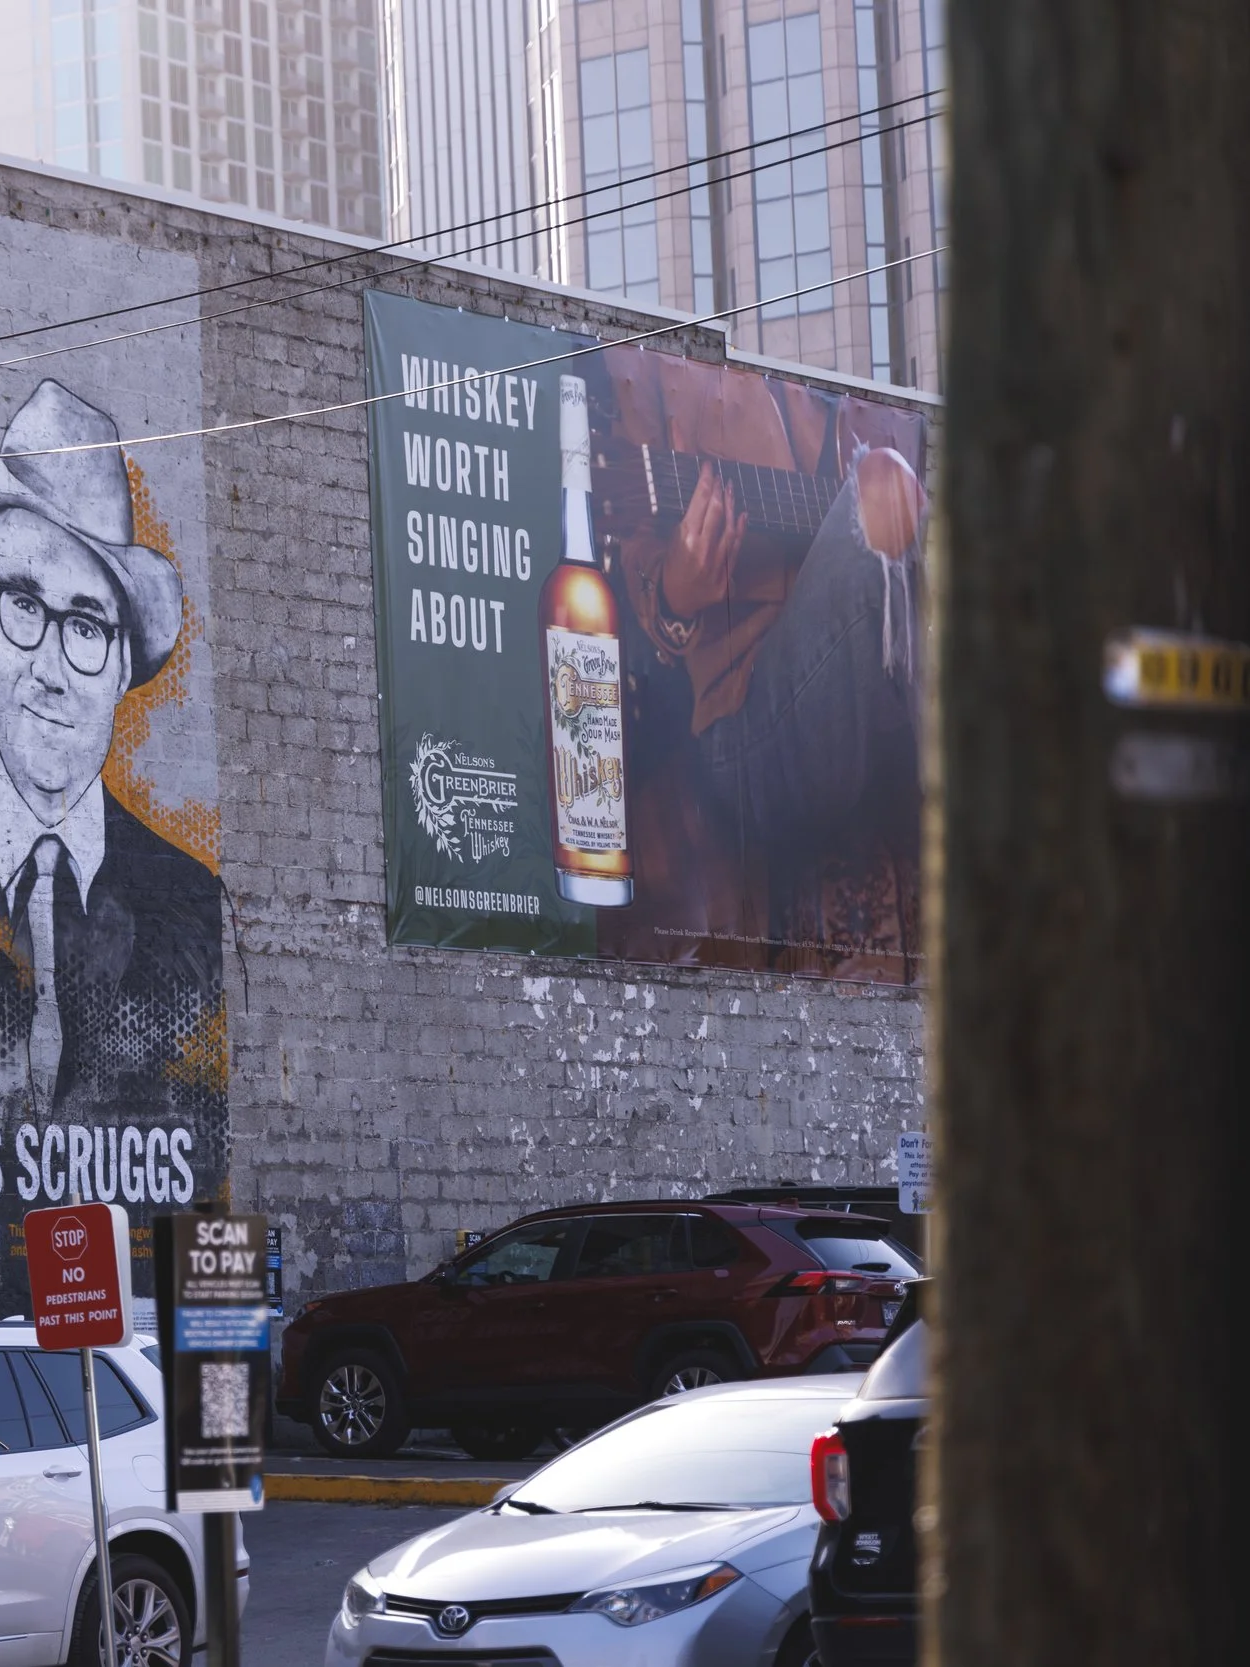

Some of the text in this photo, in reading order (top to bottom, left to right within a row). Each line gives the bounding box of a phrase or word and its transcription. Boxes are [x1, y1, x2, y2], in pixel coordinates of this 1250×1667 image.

[401, 353, 538, 431] WHISKEY
[403, 431, 510, 502] WORTH
[407, 509, 531, 582] SINGING
[410, 588, 505, 653] ABOUT
[561, 673, 618, 706] TENNESSEE
[581, 722, 620, 743] SOUR MASH
[454, 752, 495, 769] NELSON'S
[553, 744, 623, 808] Whiskey
[460, 808, 515, 838] TENNESSEE
[470, 832, 510, 864] Whiskey
[414, 885, 540, 916] @NELSONSGREENBRIER
[901, 1138, 919, 1149] Don't
[15, 1122, 194, 1204] SCRUGGS
[54, 1229, 85, 1248] STOP
[196, 1221, 249, 1246] SCAN
[62, 1266, 86, 1284] NO
[188, 1249, 217, 1275] TO
[220, 1249, 256, 1275] PAY
[46, 1289, 107, 1306] PEDESTRIANS
[39, 1314, 61, 1327] PAST
[64, 1311, 85, 1324] THIS
[88, 1308, 118, 1322] POINT
